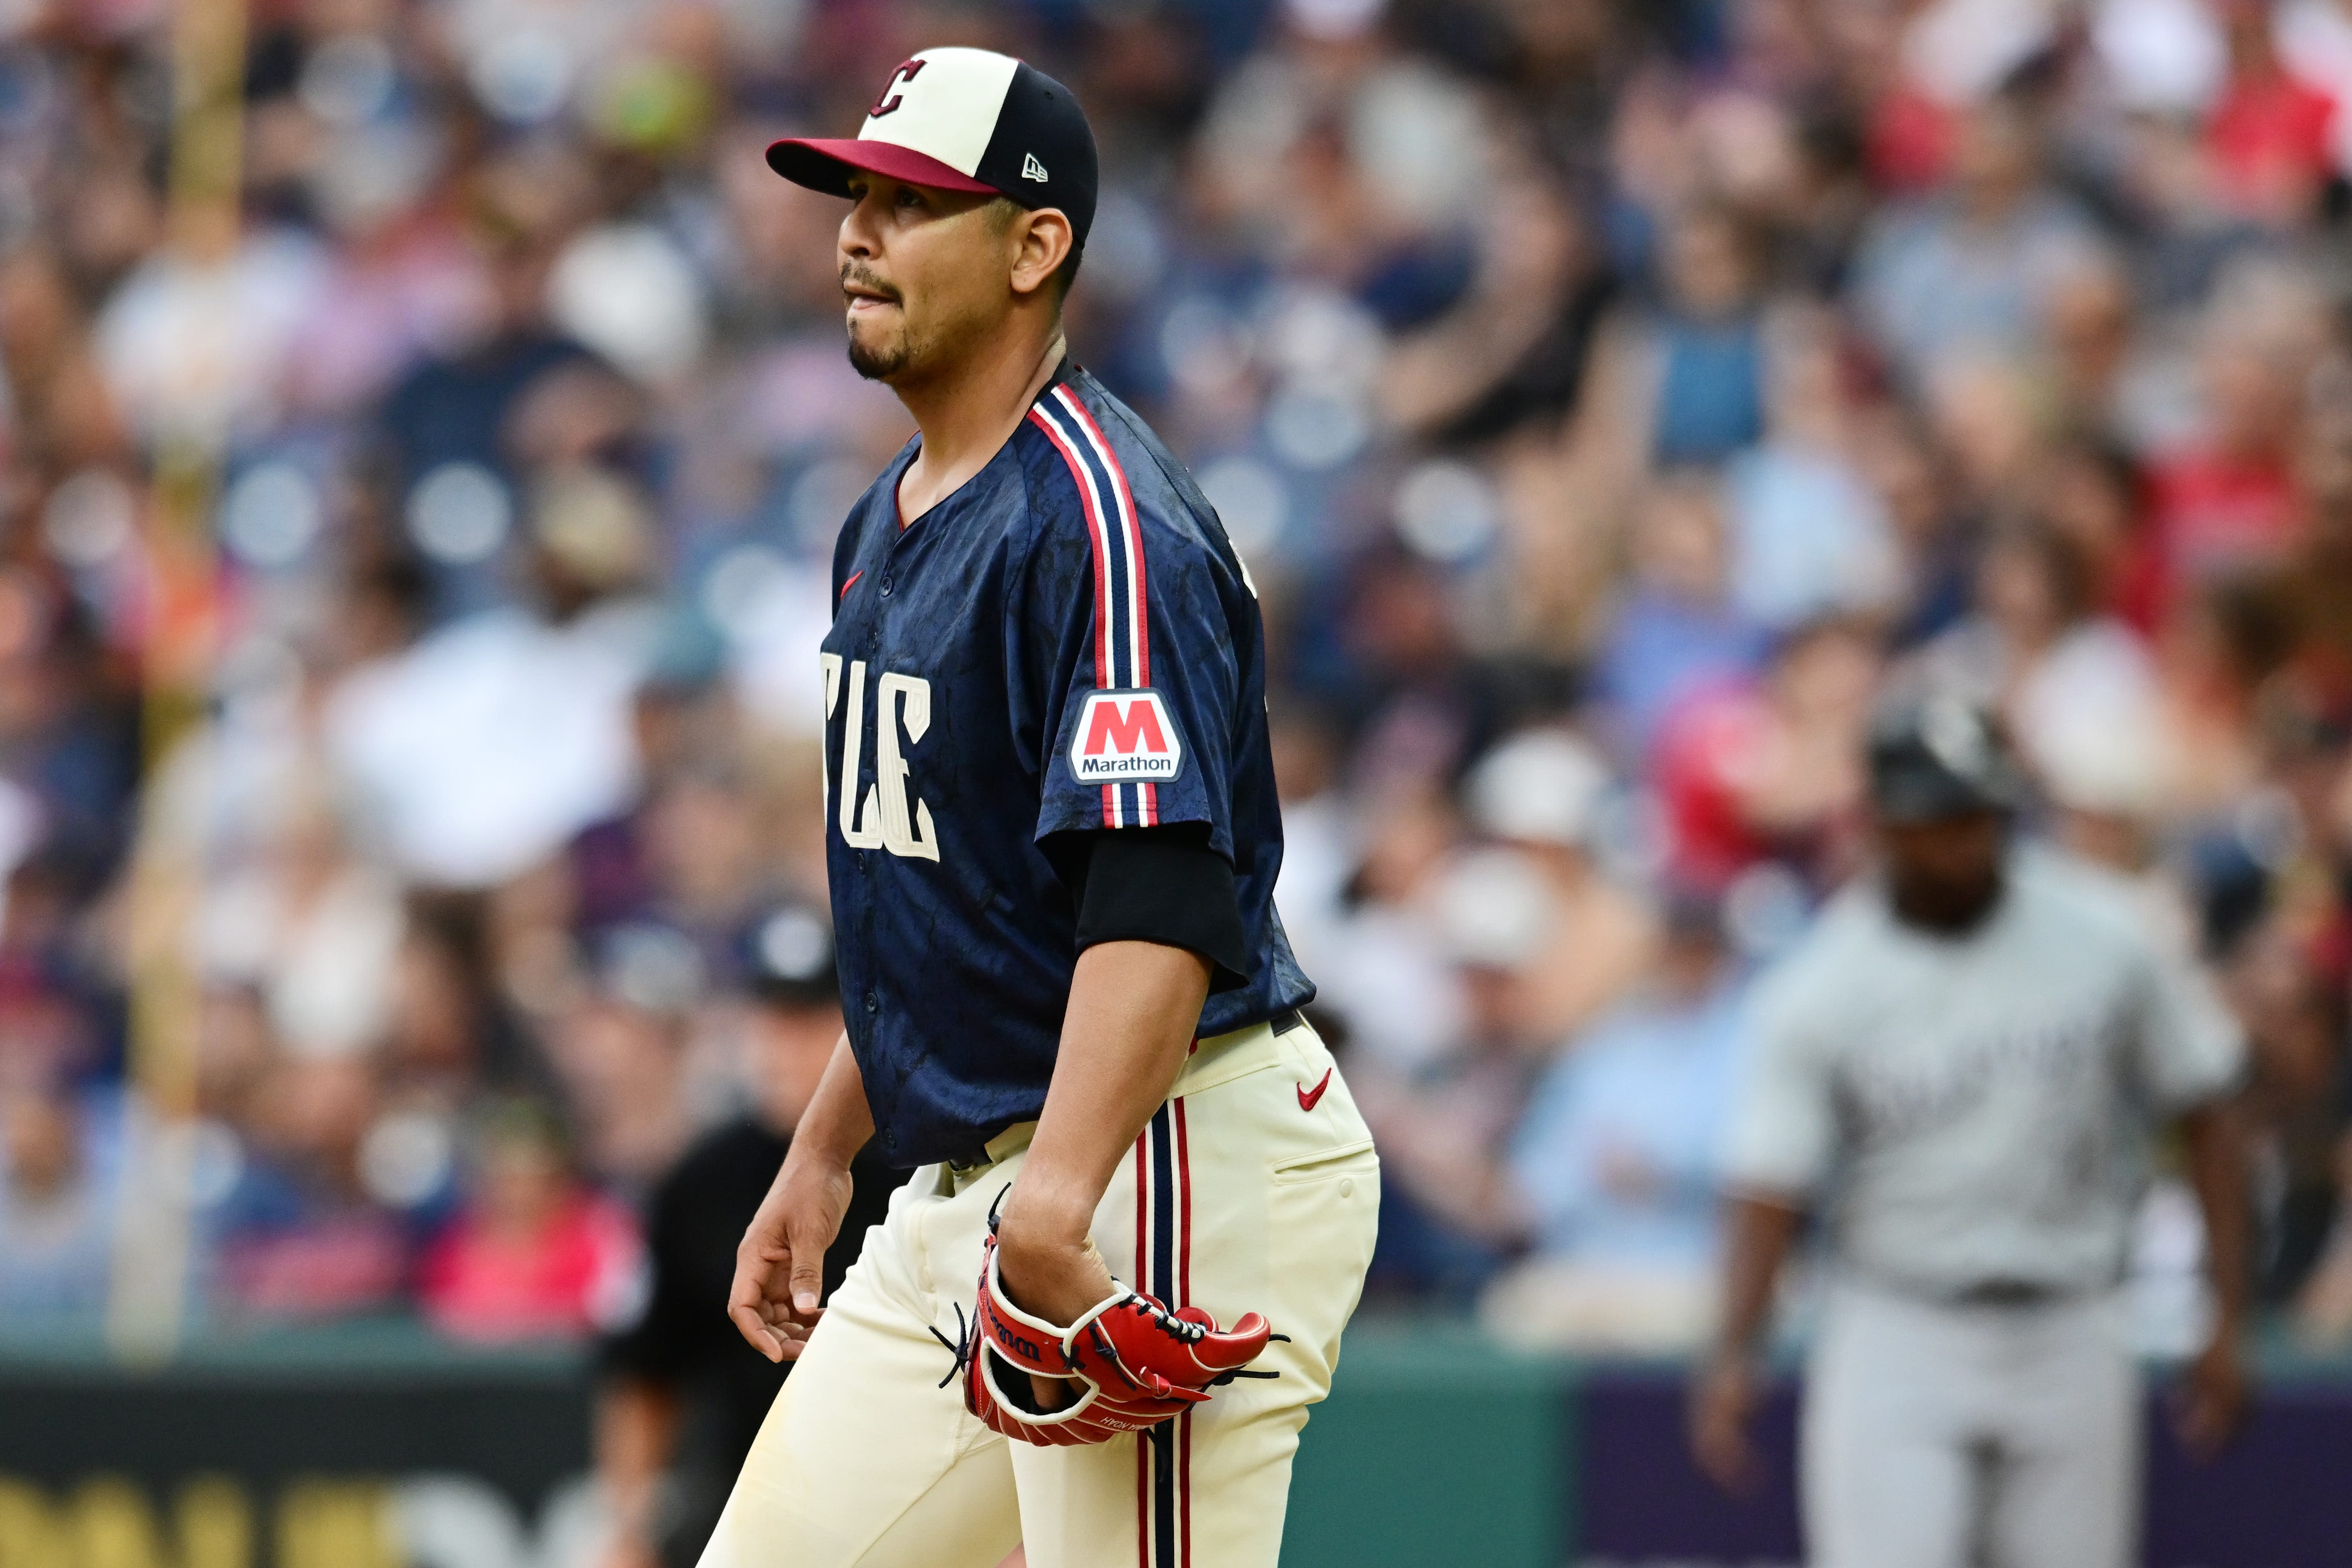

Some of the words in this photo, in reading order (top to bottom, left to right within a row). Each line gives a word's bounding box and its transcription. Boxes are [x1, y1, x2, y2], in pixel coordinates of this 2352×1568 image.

[870, 59, 927, 116] C
[1084, 700, 1168, 755] M
[1082, 757, 1171, 773] Marathon
[1100, 1416, 1130, 1429] NOAH
